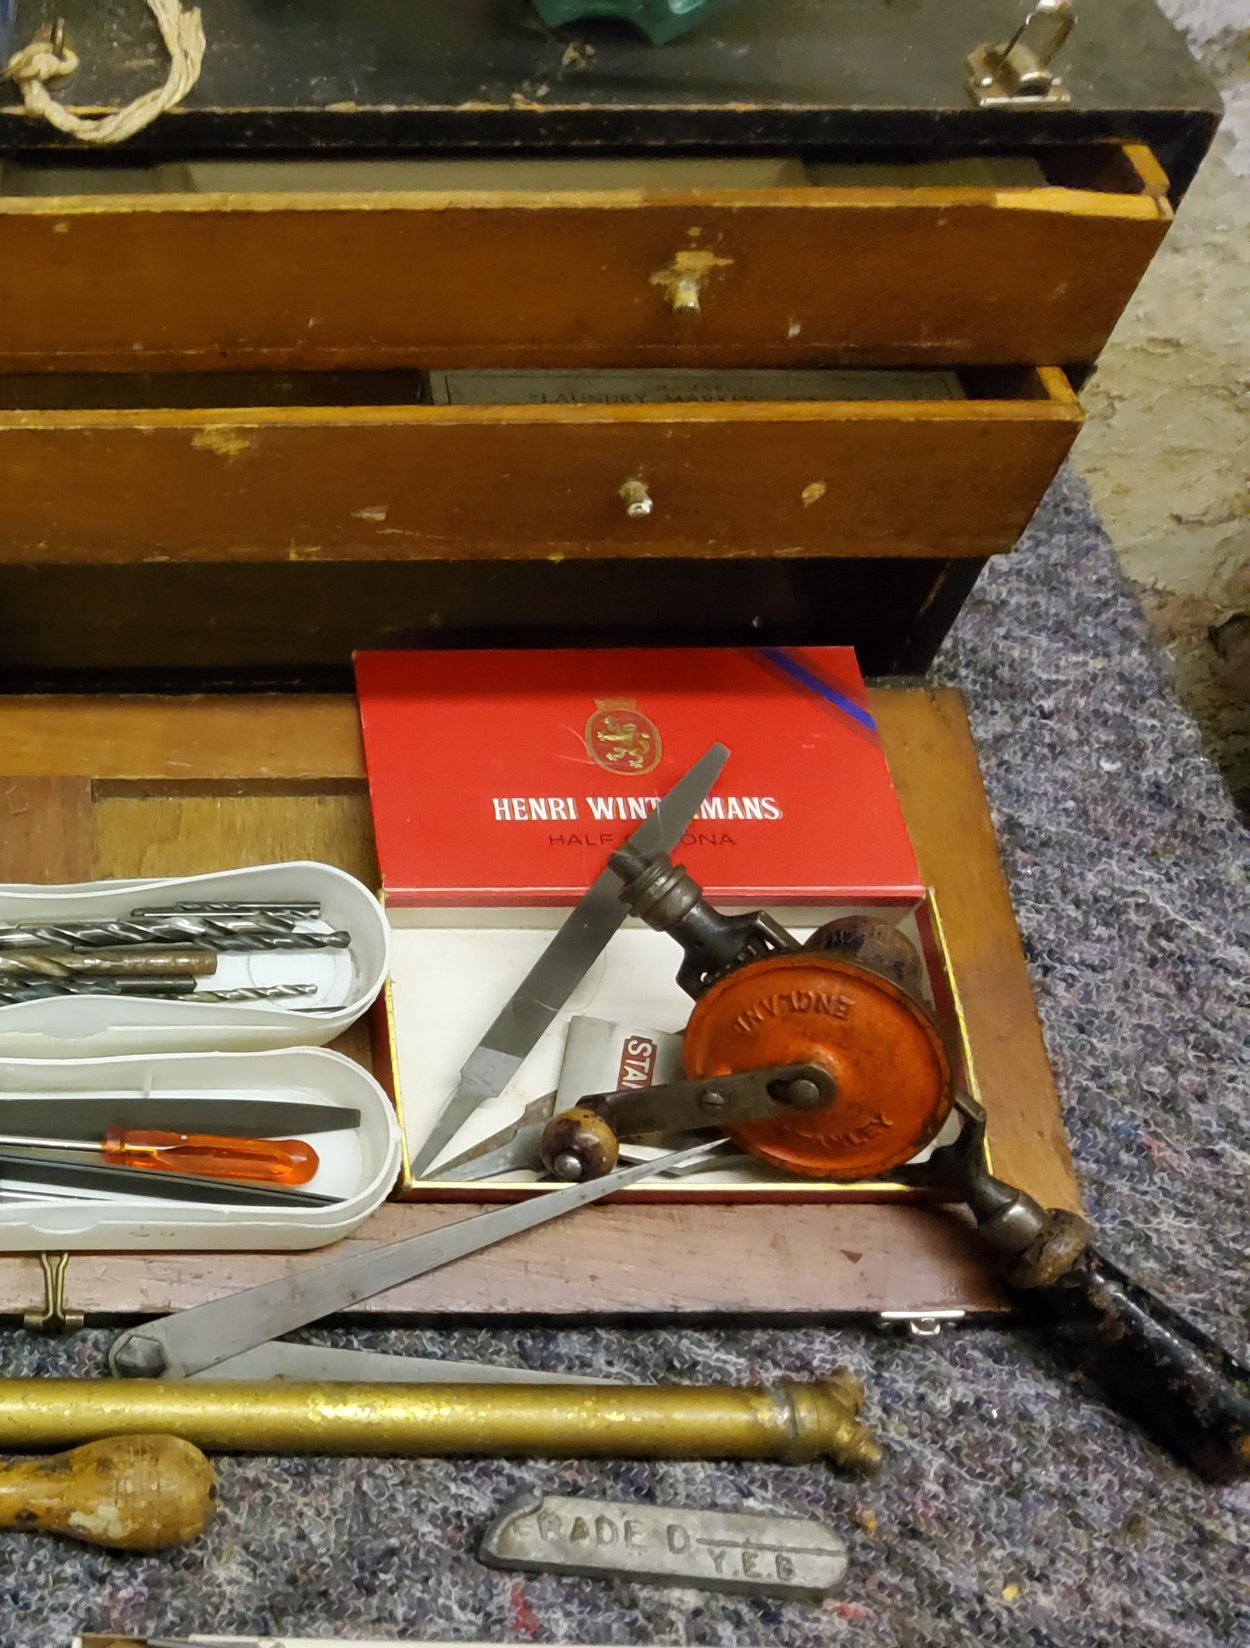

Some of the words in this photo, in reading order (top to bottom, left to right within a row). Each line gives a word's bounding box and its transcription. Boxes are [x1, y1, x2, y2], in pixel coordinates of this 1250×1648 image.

[492, 797, 577, 821] HENRI
[586, 797, 782, 820] WINTMANS
[548, 834, 614, 846] HALF
[734, 990, 855, 1033] ENGLAND
